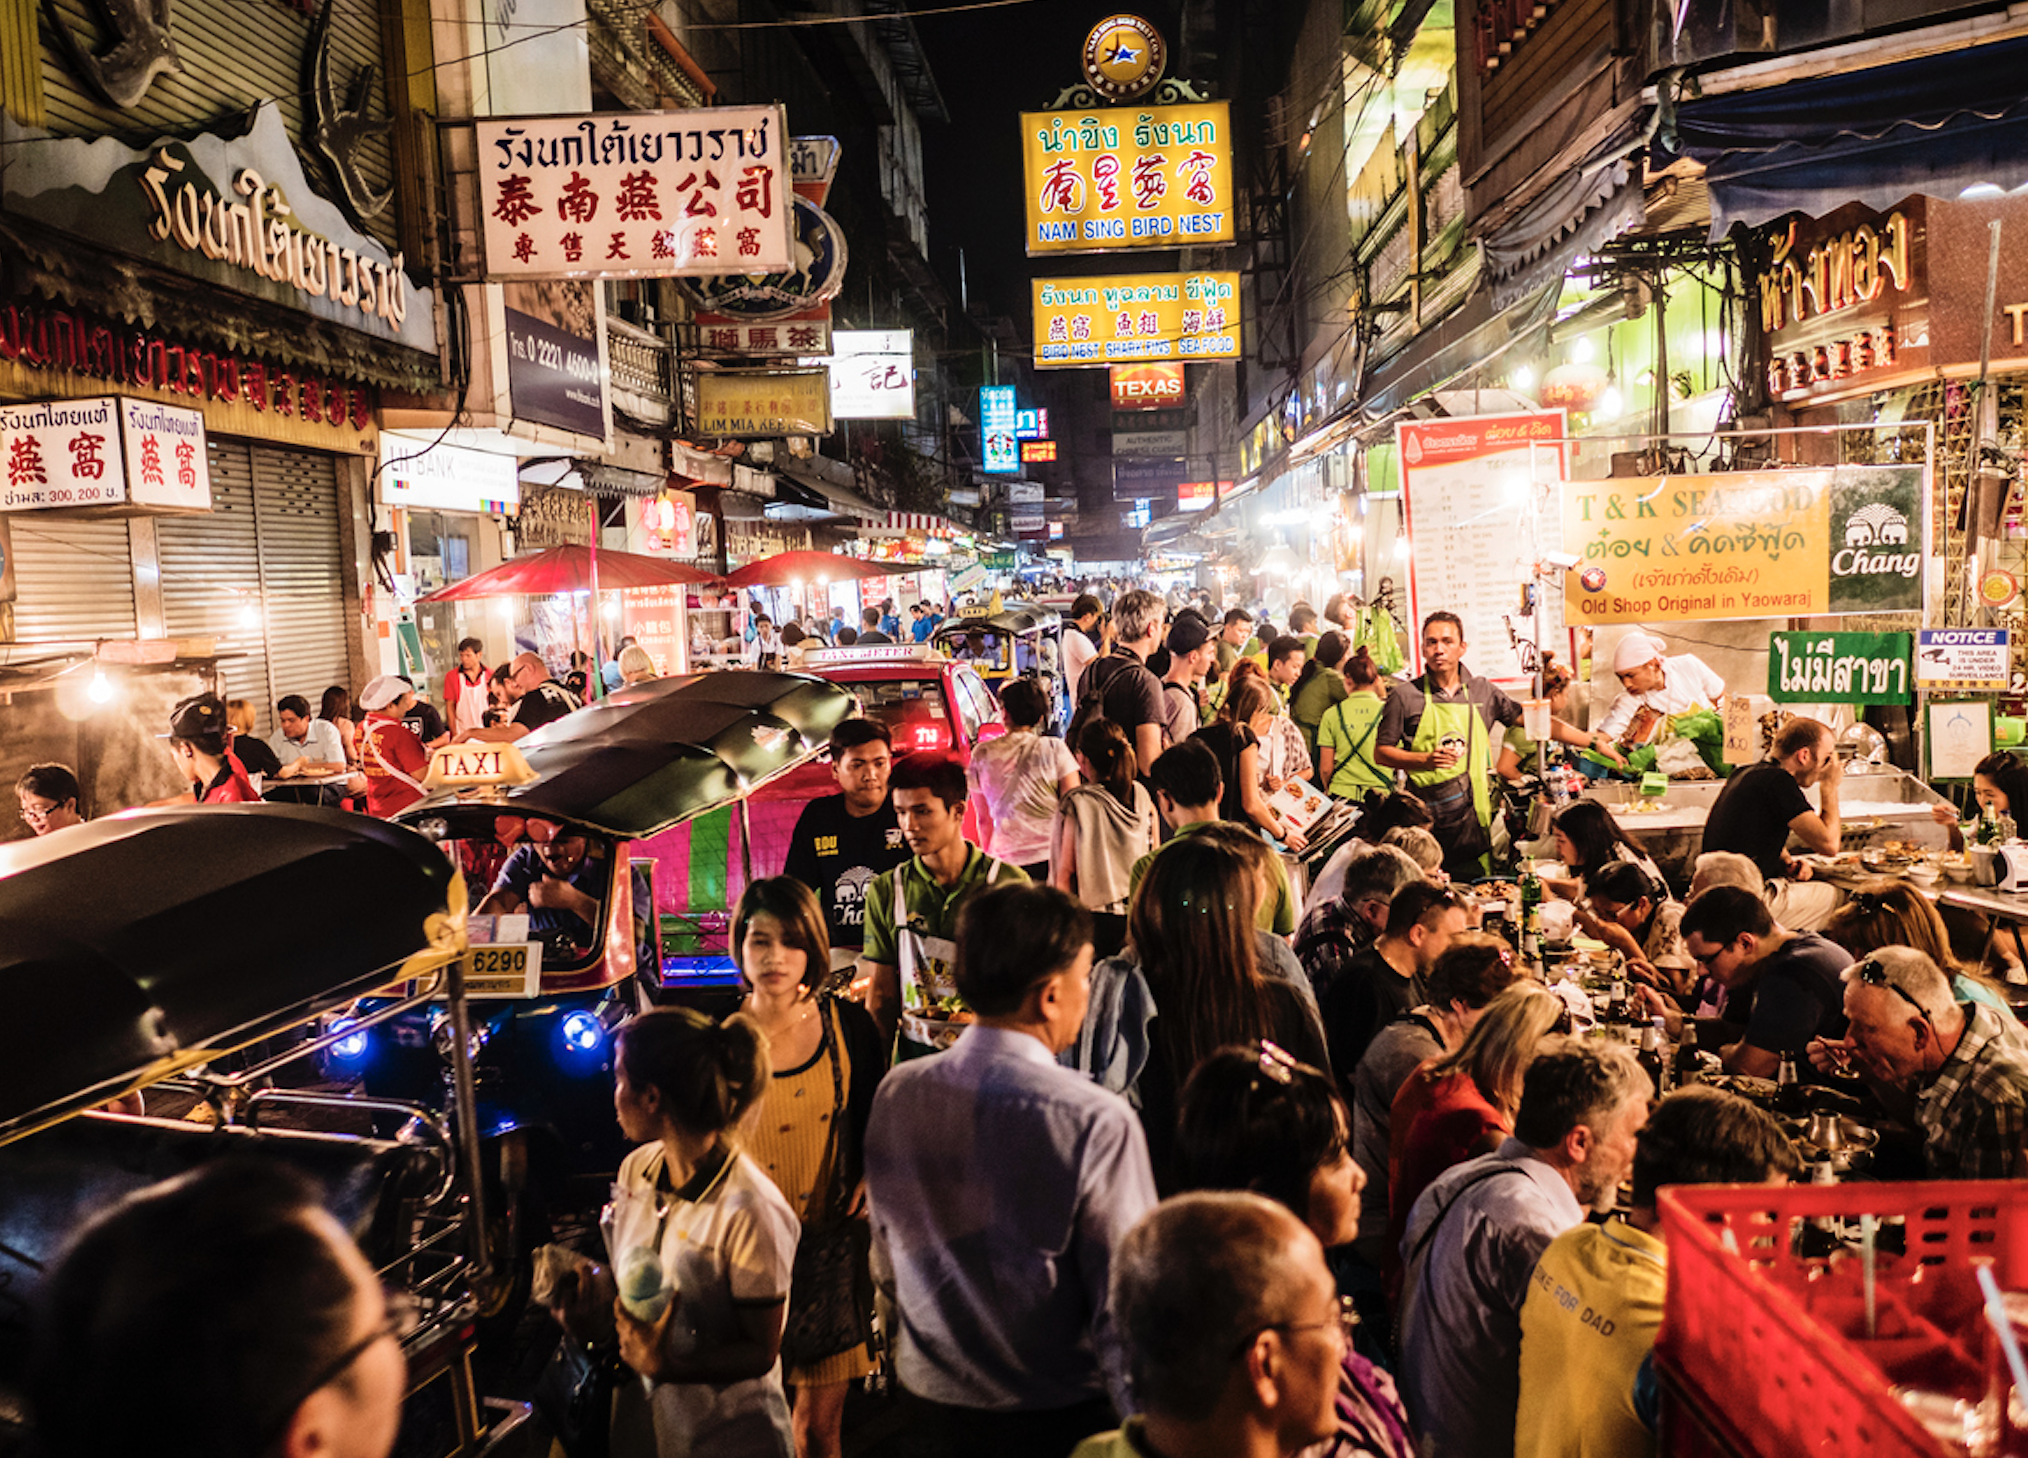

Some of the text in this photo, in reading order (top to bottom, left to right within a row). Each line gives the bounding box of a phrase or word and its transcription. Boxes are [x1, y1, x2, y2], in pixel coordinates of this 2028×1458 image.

[494, 117, 769, 169] รังนกใต้เยาวราช
[1135, 114, 1216, 147] รังนก
[492, 165, 773, 227] 泰南燕公司
[139, 147, 406, 330] รังนกใต้เยาวราช
[1039, 213, 1223, 242] NAM SING BIRD NEST
[1757, 211, 1910, 334] ห้างทอง
[1041, 284, 1098, 306] รังนก
[528, 334, 536, 363] 0
[537, 338, 563, 372] 2221
[708, 327, 822, 350] 獅馬茶
[1042, 343, 1070, 361] BIRD
[1071, 342, 1100, 359] NEST
[1105, 340, 1144, 357] SHARK
[1145, 338, 1170, 356] FINS
[1114, 379, 1182, 396] TEXAS
[0, 400, 111, 432] รังนกไทยแท้
[704, 418, 727, 432] LIM
[730, 418, 755, 432] MIA
[759, 418, 786, 432] KEE
[8, 431, 106, 487] 燕窩
[140, 433, 197, 490] 燕窩
[416, 451, 456, 479] BANK
[1577, 494, 1597, 521] T
[1605, 493, 1627, 520] &
[1636, 491, 1659, 518] K
[1661, 532, 1681, 557] &
[1831, 547, 1922, 578] Chang
[1581, 588, 1812, 616] Old Shop Original in Yaowaraj
[1931, 632, 1997, 644] NOTICE
[1773, 636, 1908, 696] ไม่มีสาขา
[440, 751, 502, 776] TAXI
[473, 950, 526, 973] 6290
[1553, 1284, 1580, 1313] FOR
[1580, 1307, 1616, 1337] DAD
